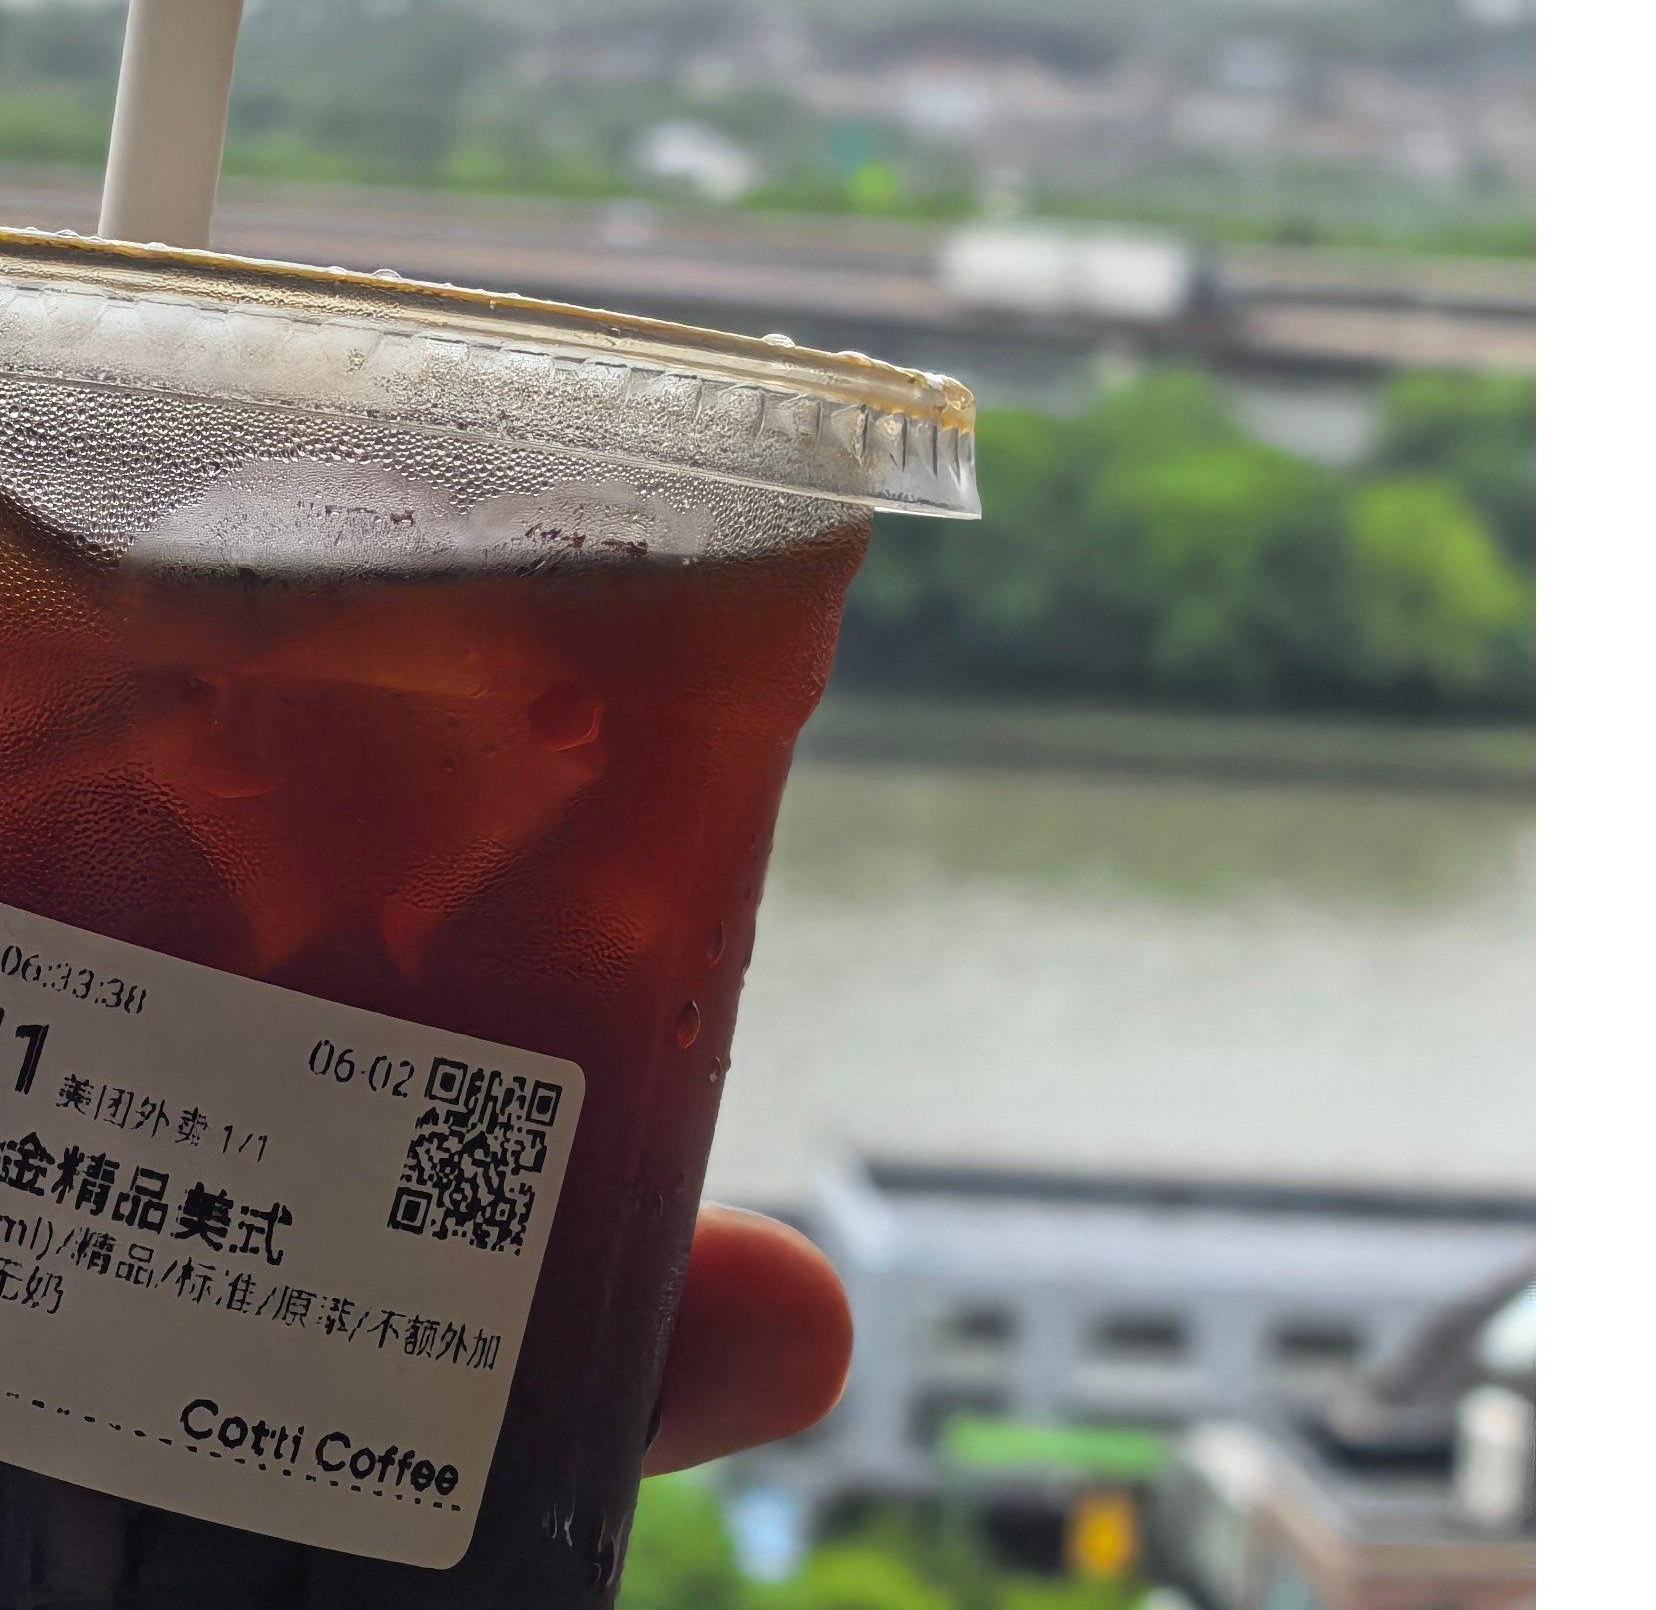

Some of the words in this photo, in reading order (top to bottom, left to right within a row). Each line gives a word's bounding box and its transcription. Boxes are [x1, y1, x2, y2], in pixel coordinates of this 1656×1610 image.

[309, 1040, 414, 1098] 06-02
[223, 1125, 267, 1162] 1/1
[180, 1399, 304, 1464] Cotti
[315, 1431, 458, 1496] Coffee
